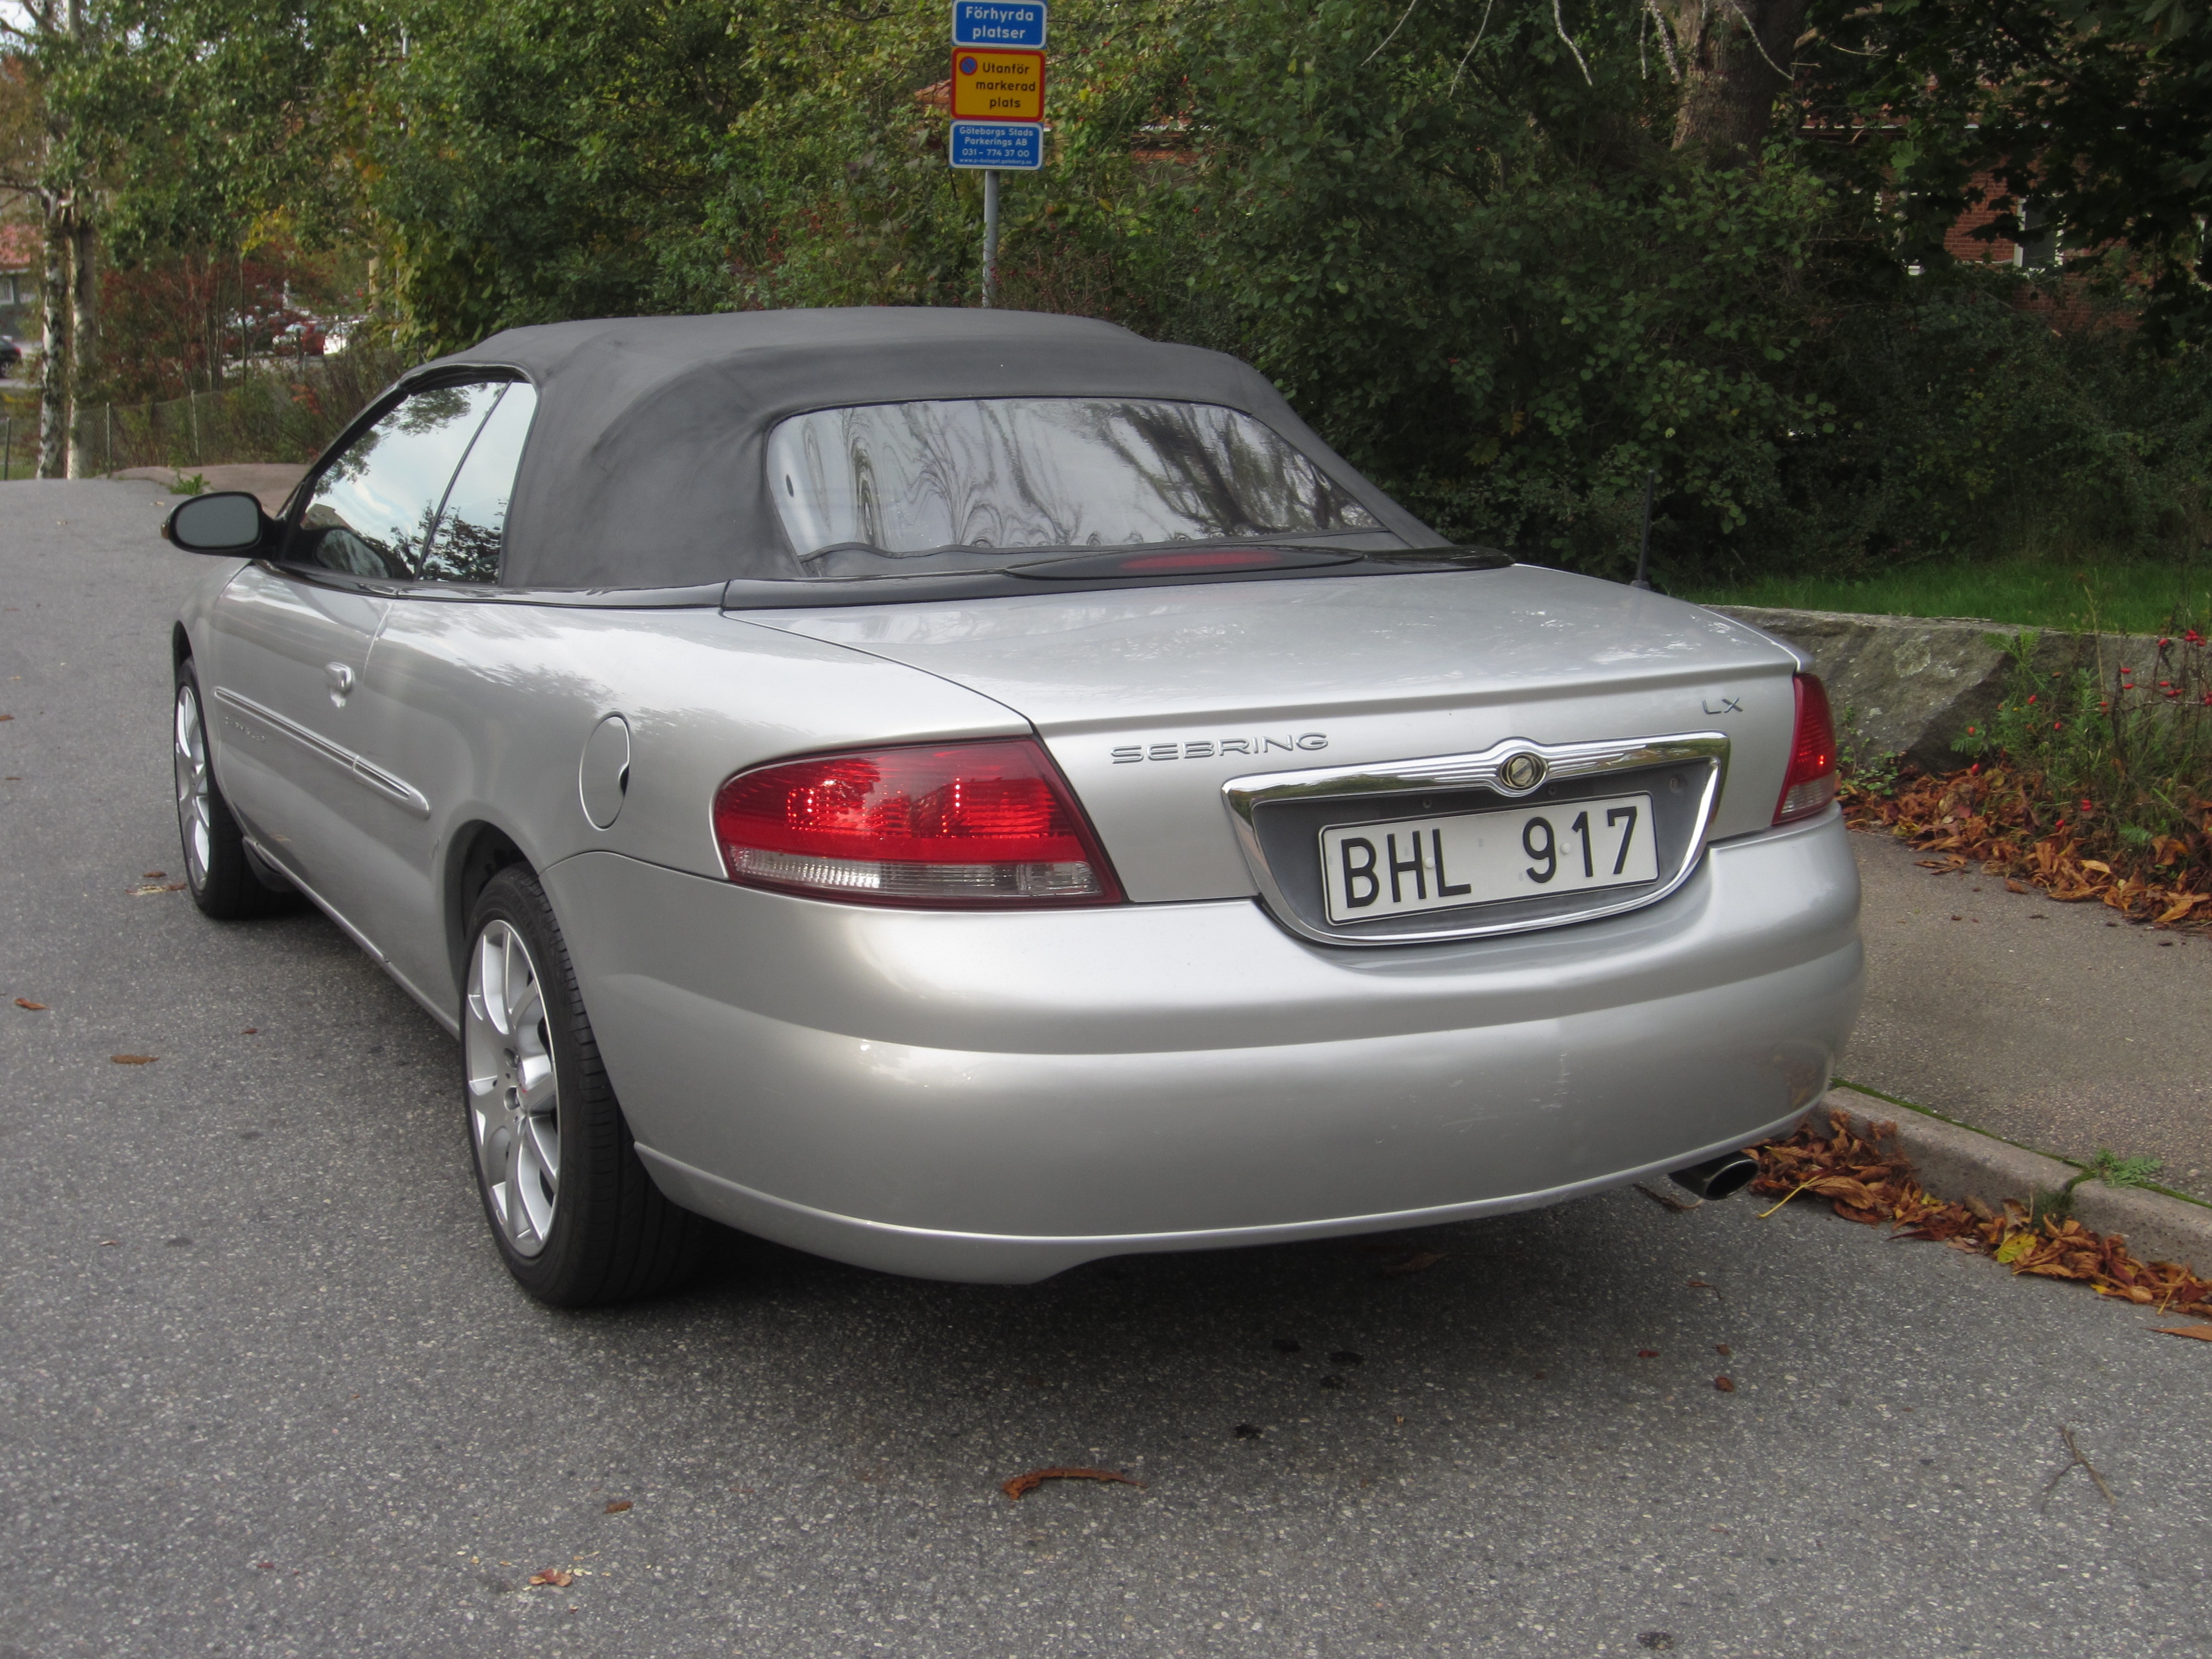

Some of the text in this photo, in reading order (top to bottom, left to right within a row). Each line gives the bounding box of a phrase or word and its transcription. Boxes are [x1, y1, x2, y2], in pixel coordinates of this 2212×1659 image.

[966, 6, 1034, 23] Förhyrda
[973, 25, 1026, 40] platser
[983, 62, 1029, 74] Utanför
[976, 80, 1036, 91] markerad
[989, 97, 1020, 109] plats
[959, 127, 1033, 137] Göteborgs Stads
[964, 137, 1012, 147] Parkerings
[1702, 697, 1743, 714] LX
[1110, 732, 1328, 764] SEBRING
[1340, 806, 1637, 909] BHL 917
